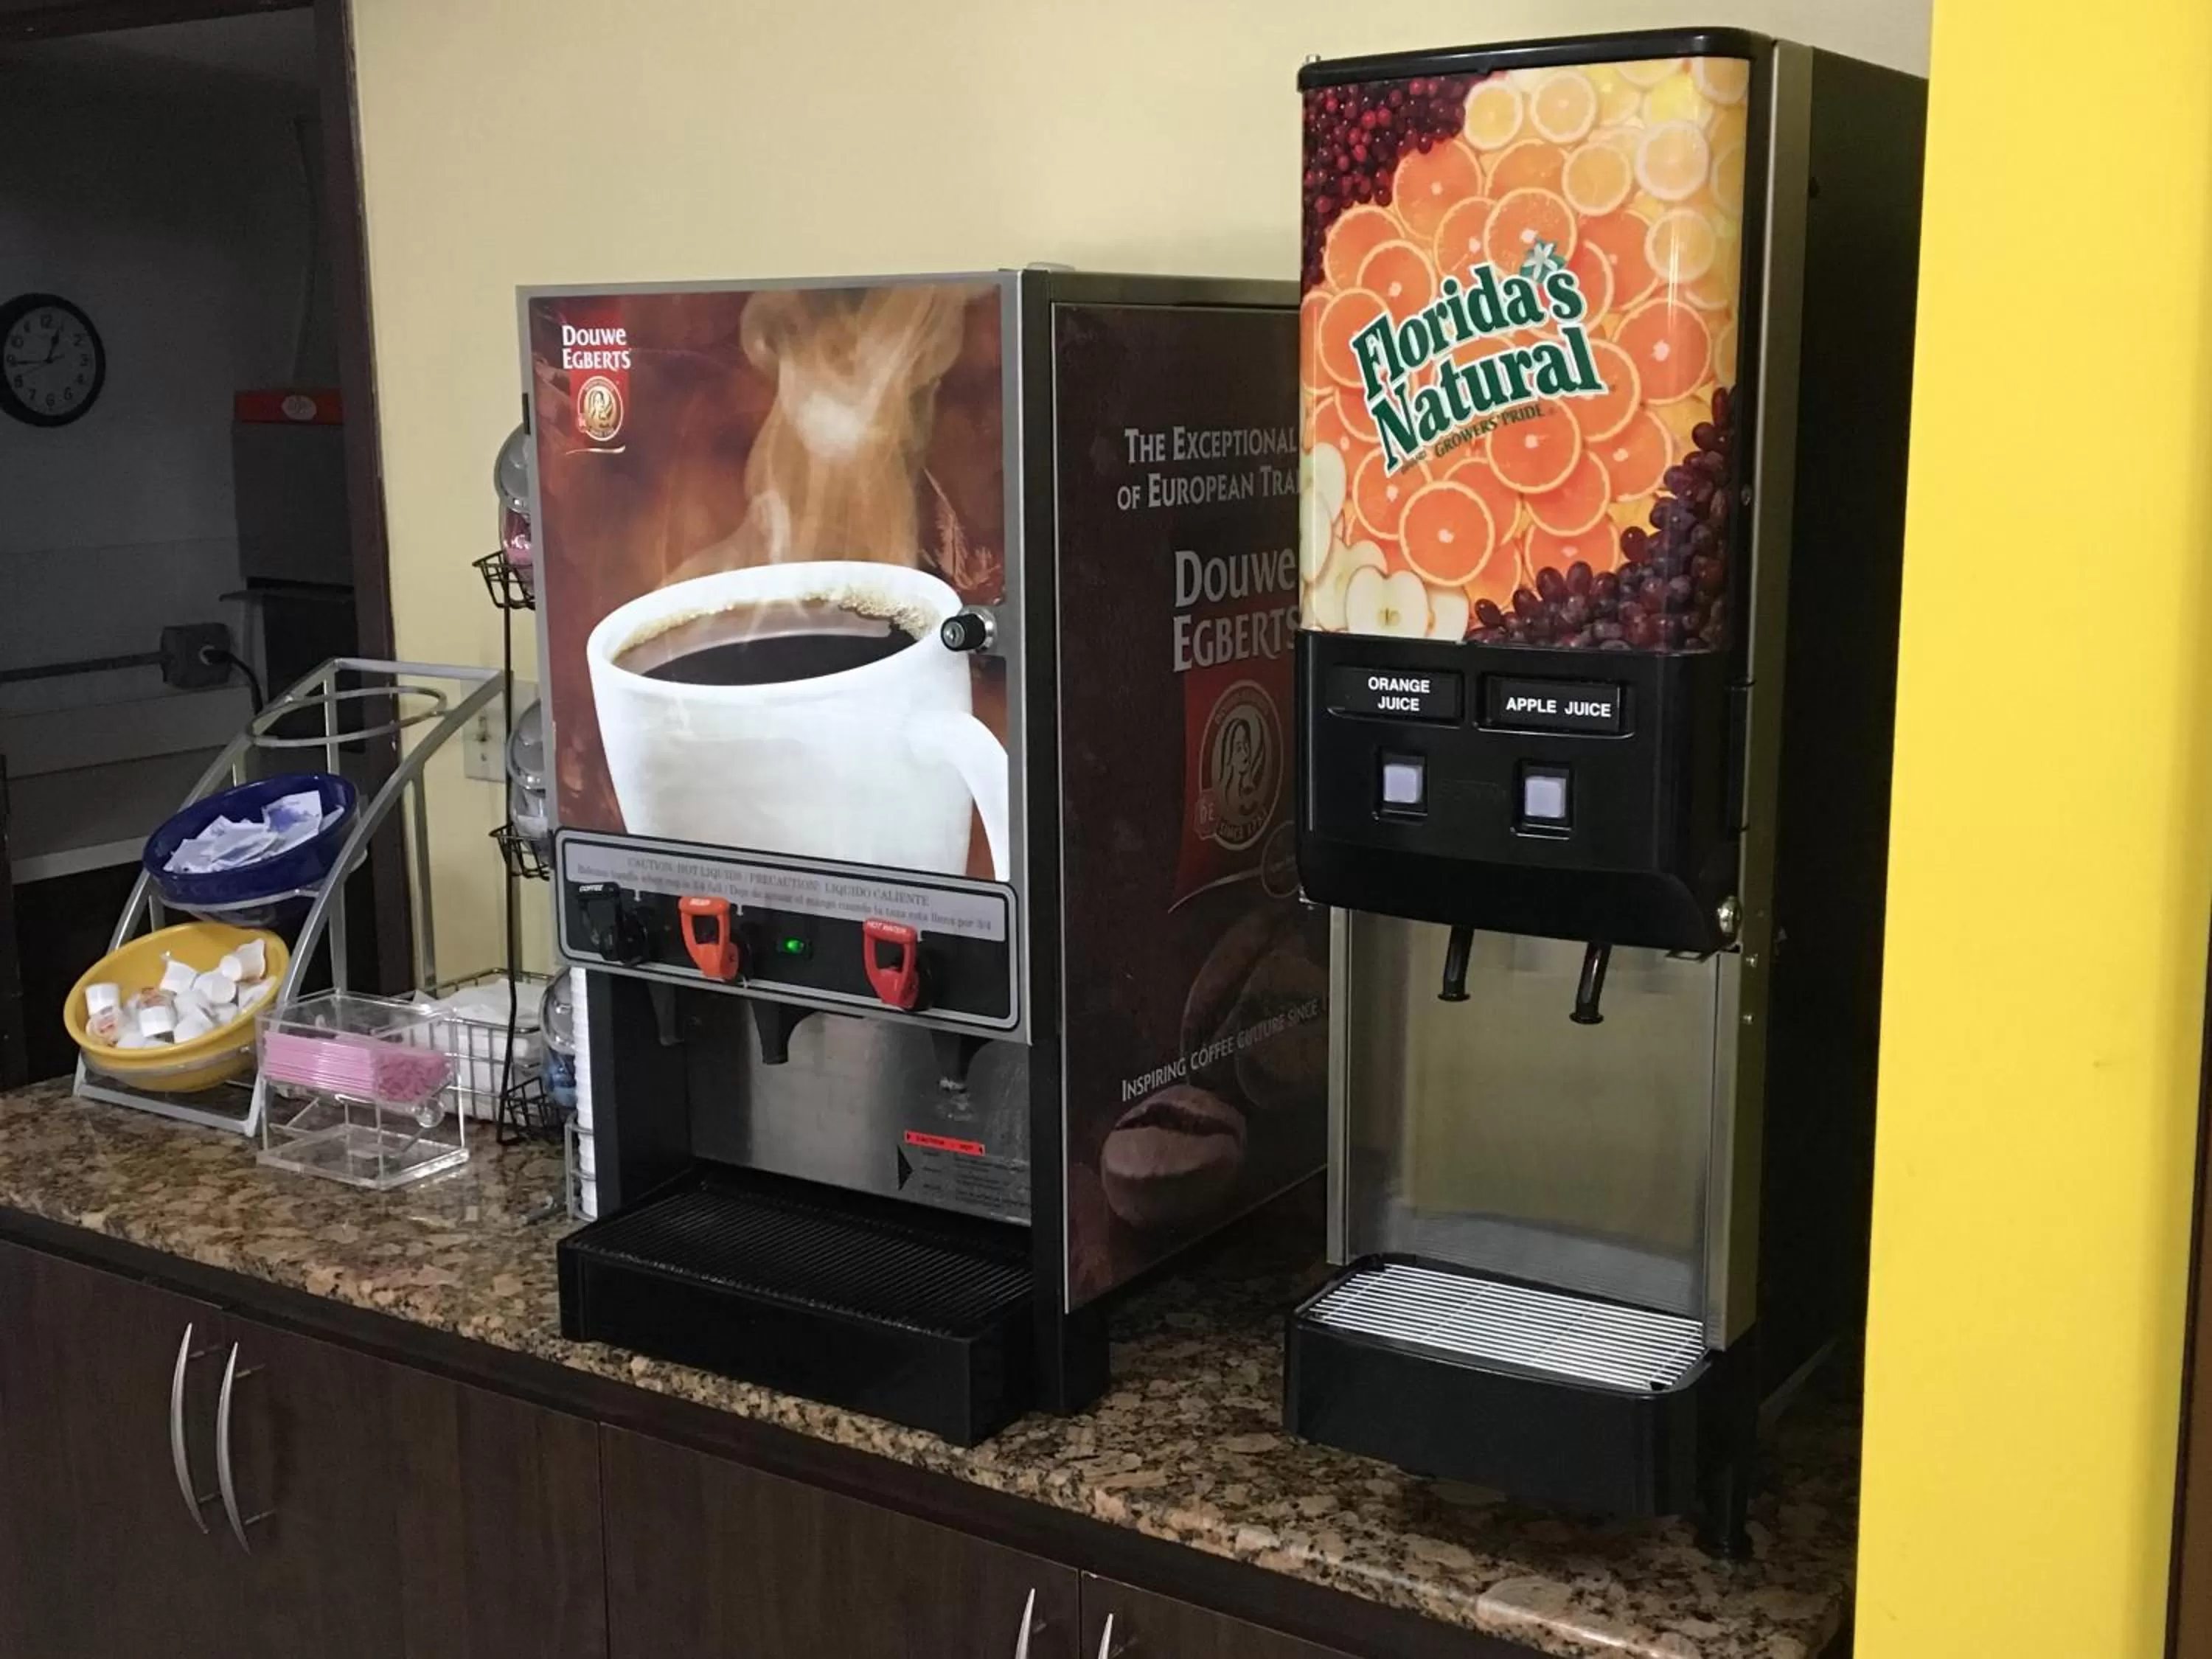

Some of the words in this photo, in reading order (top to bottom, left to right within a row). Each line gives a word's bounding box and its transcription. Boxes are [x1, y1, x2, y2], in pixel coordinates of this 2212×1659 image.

[1351, 264, 1585, 403] Florida's
[1371, 323, 1608, 478] Natural
[1503, 403, 1545, 425] PRIDE
[1260, 465, 1299, 497] TRA
[1368, 677, 1430, 693] ORANGE
[1377, 696, 1419, 712] JUICE
[1506, 697, 1557, 714] APPLE
[1564, 701, 1611, 717] JUICE
[873, 887, 930, 906] CALIENTE
